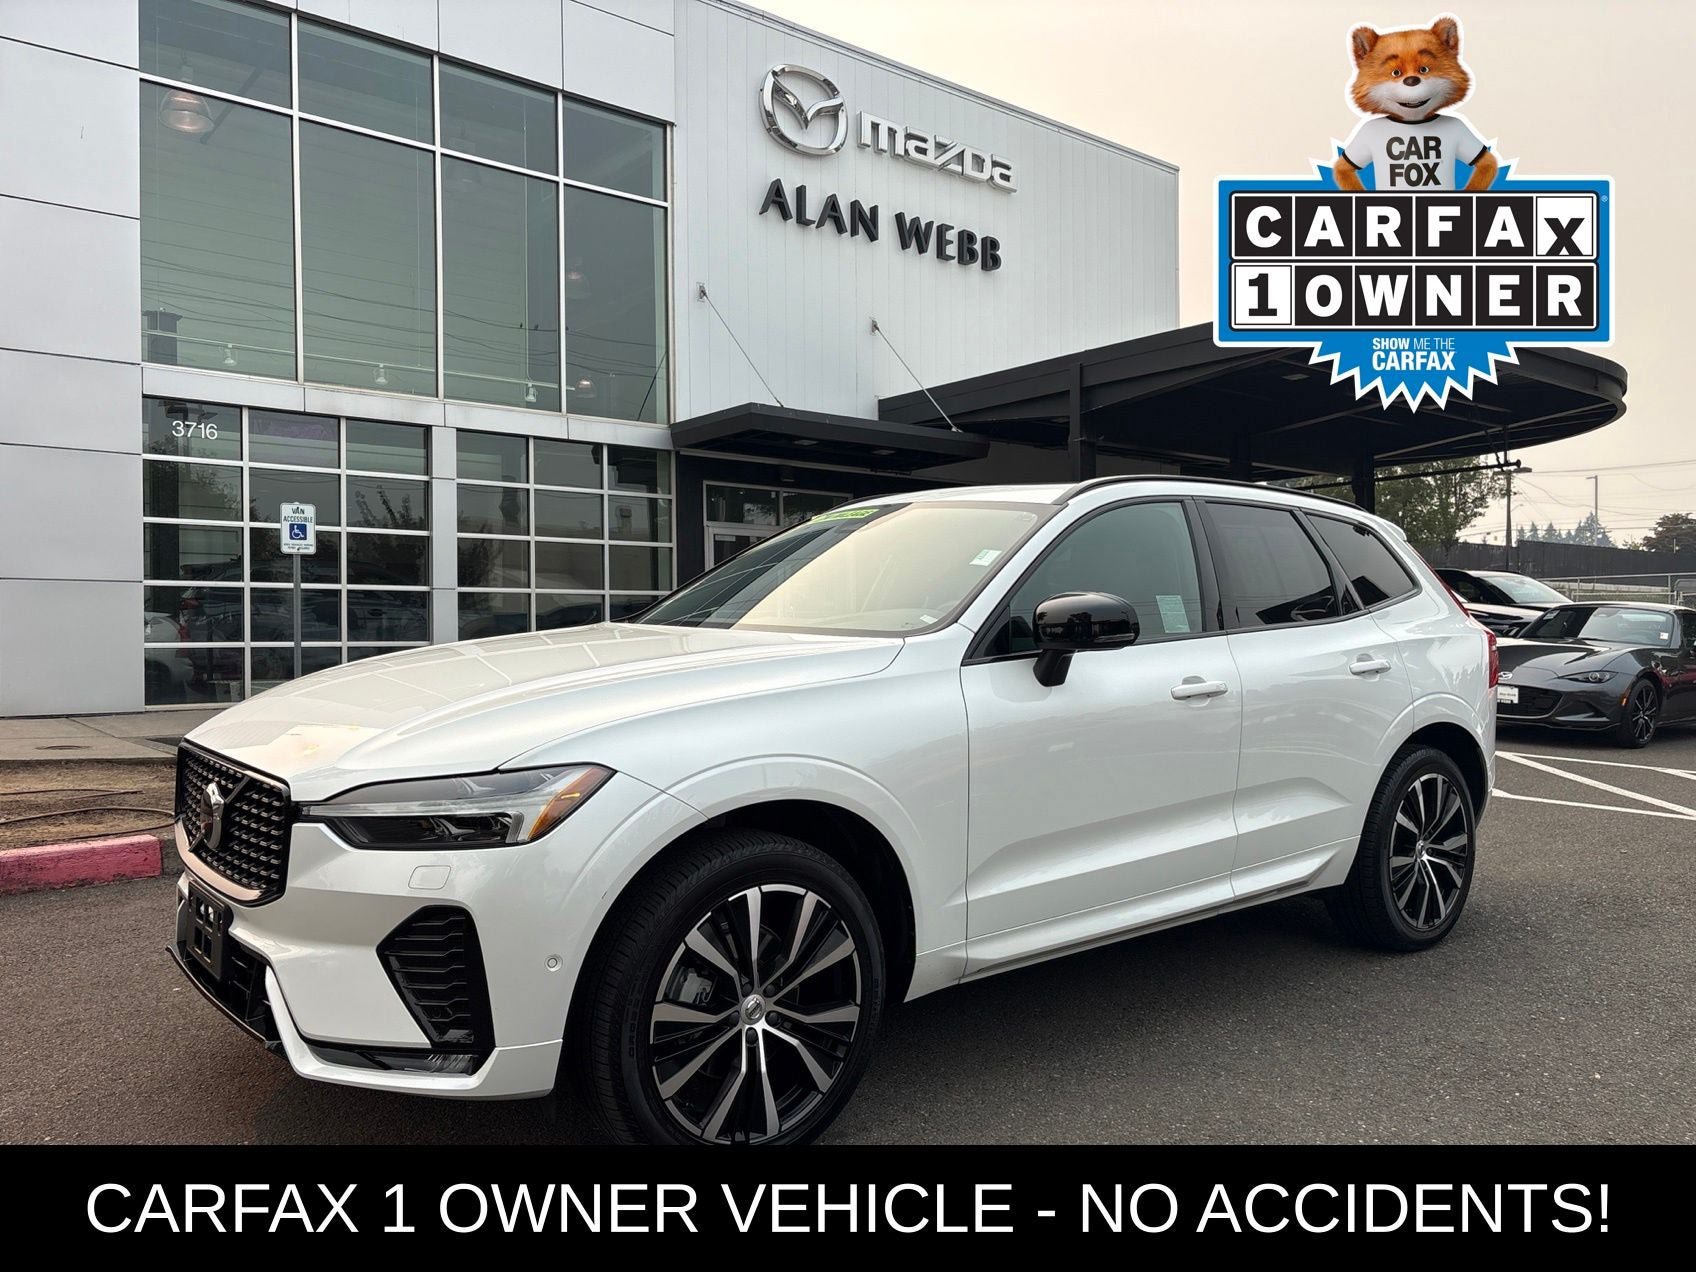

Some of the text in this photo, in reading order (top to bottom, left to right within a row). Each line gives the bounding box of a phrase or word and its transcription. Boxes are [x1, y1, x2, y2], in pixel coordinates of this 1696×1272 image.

[759, 178, 1002, 272] ALAN WEBB
[171, 420, 218, 440] 3716
[291, 507, 305, 515] VAN
[283, 515, 313, 523] ACCESSIBLE
